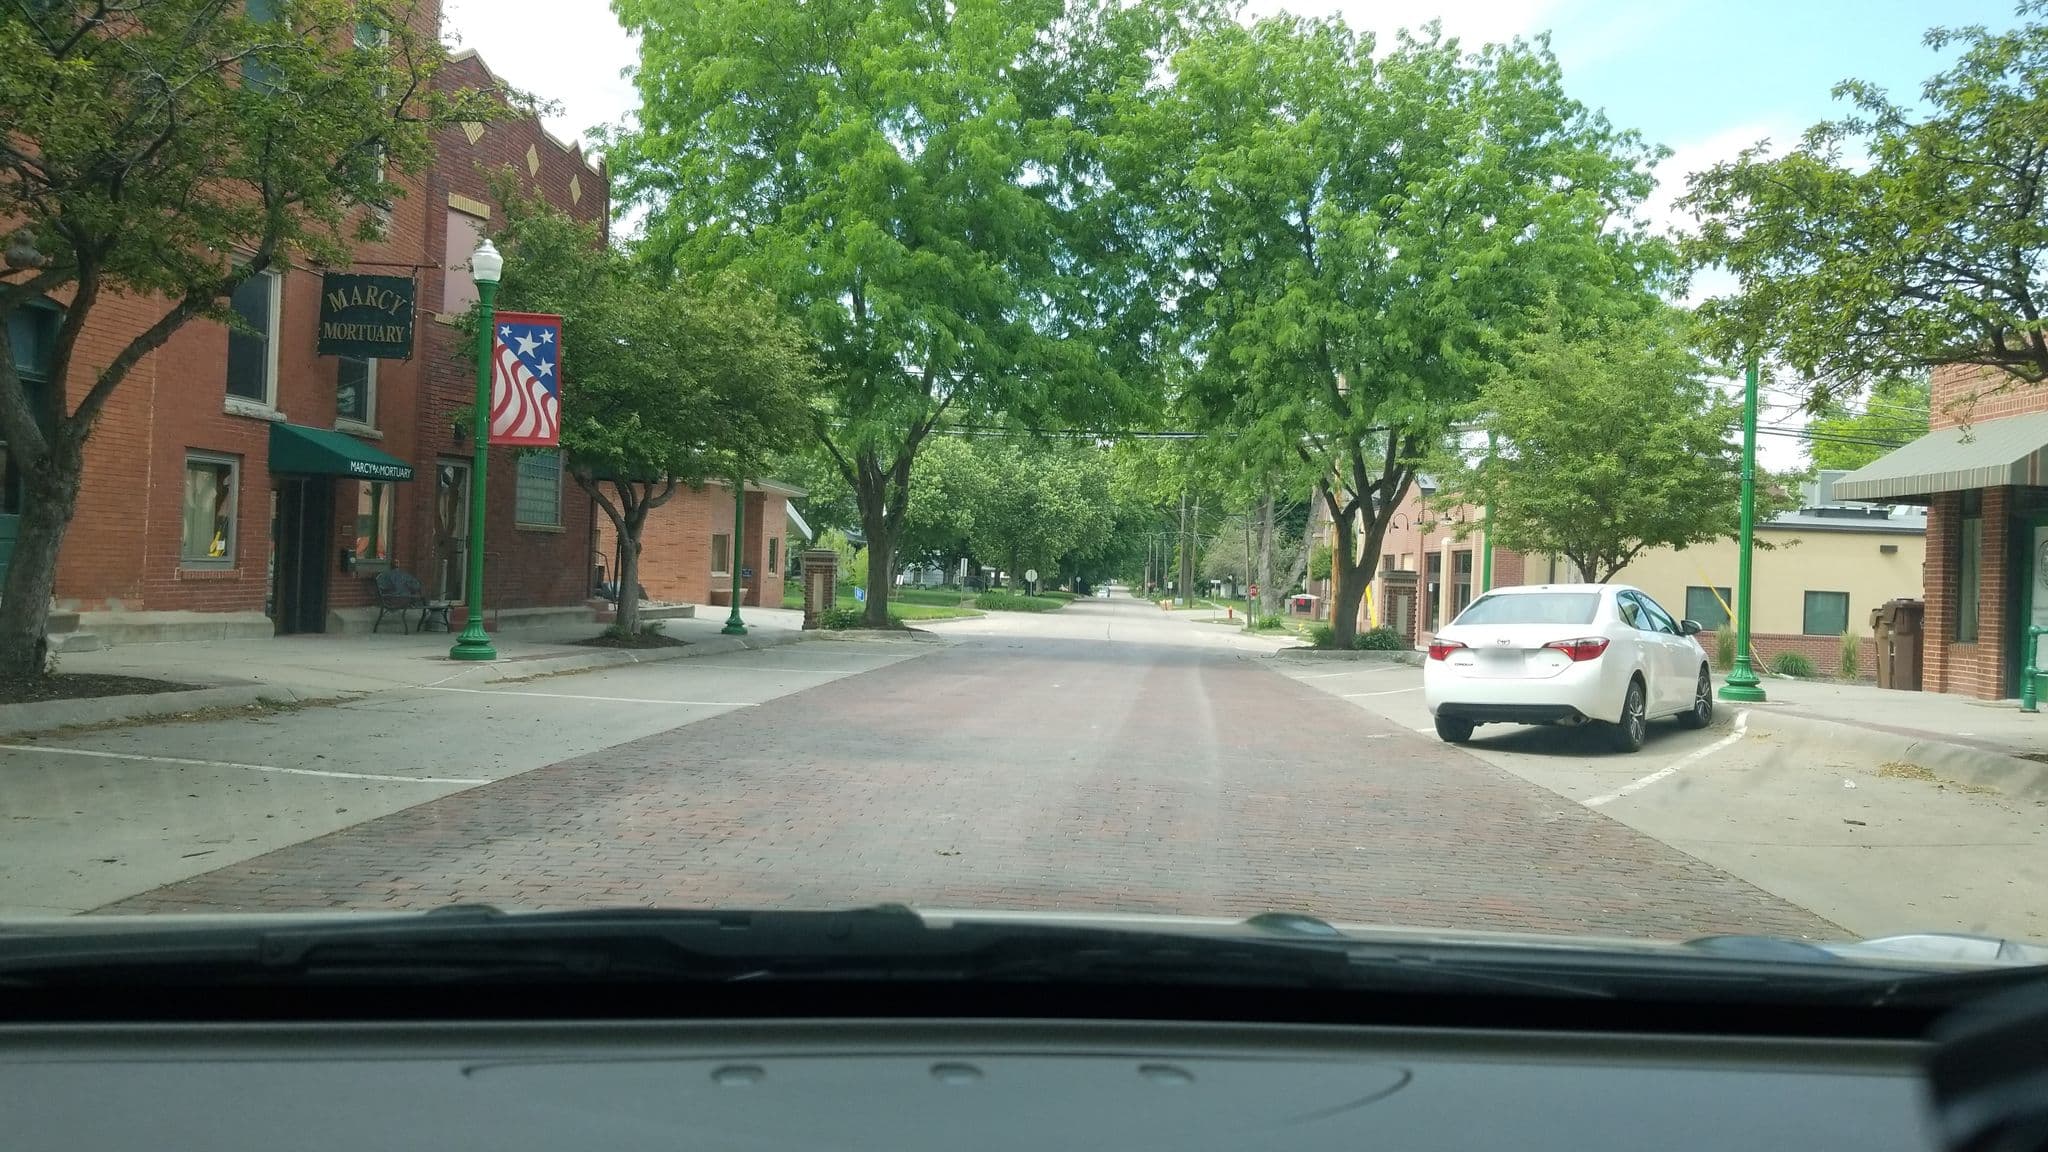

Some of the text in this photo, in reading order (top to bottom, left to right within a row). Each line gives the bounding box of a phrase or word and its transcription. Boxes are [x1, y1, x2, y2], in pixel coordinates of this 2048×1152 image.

[327, 285, 407, 315] MARCY
[323, 322, 405, 342] MORTUARY
[350, 460, 411, 478] MARCY MORTUARY
